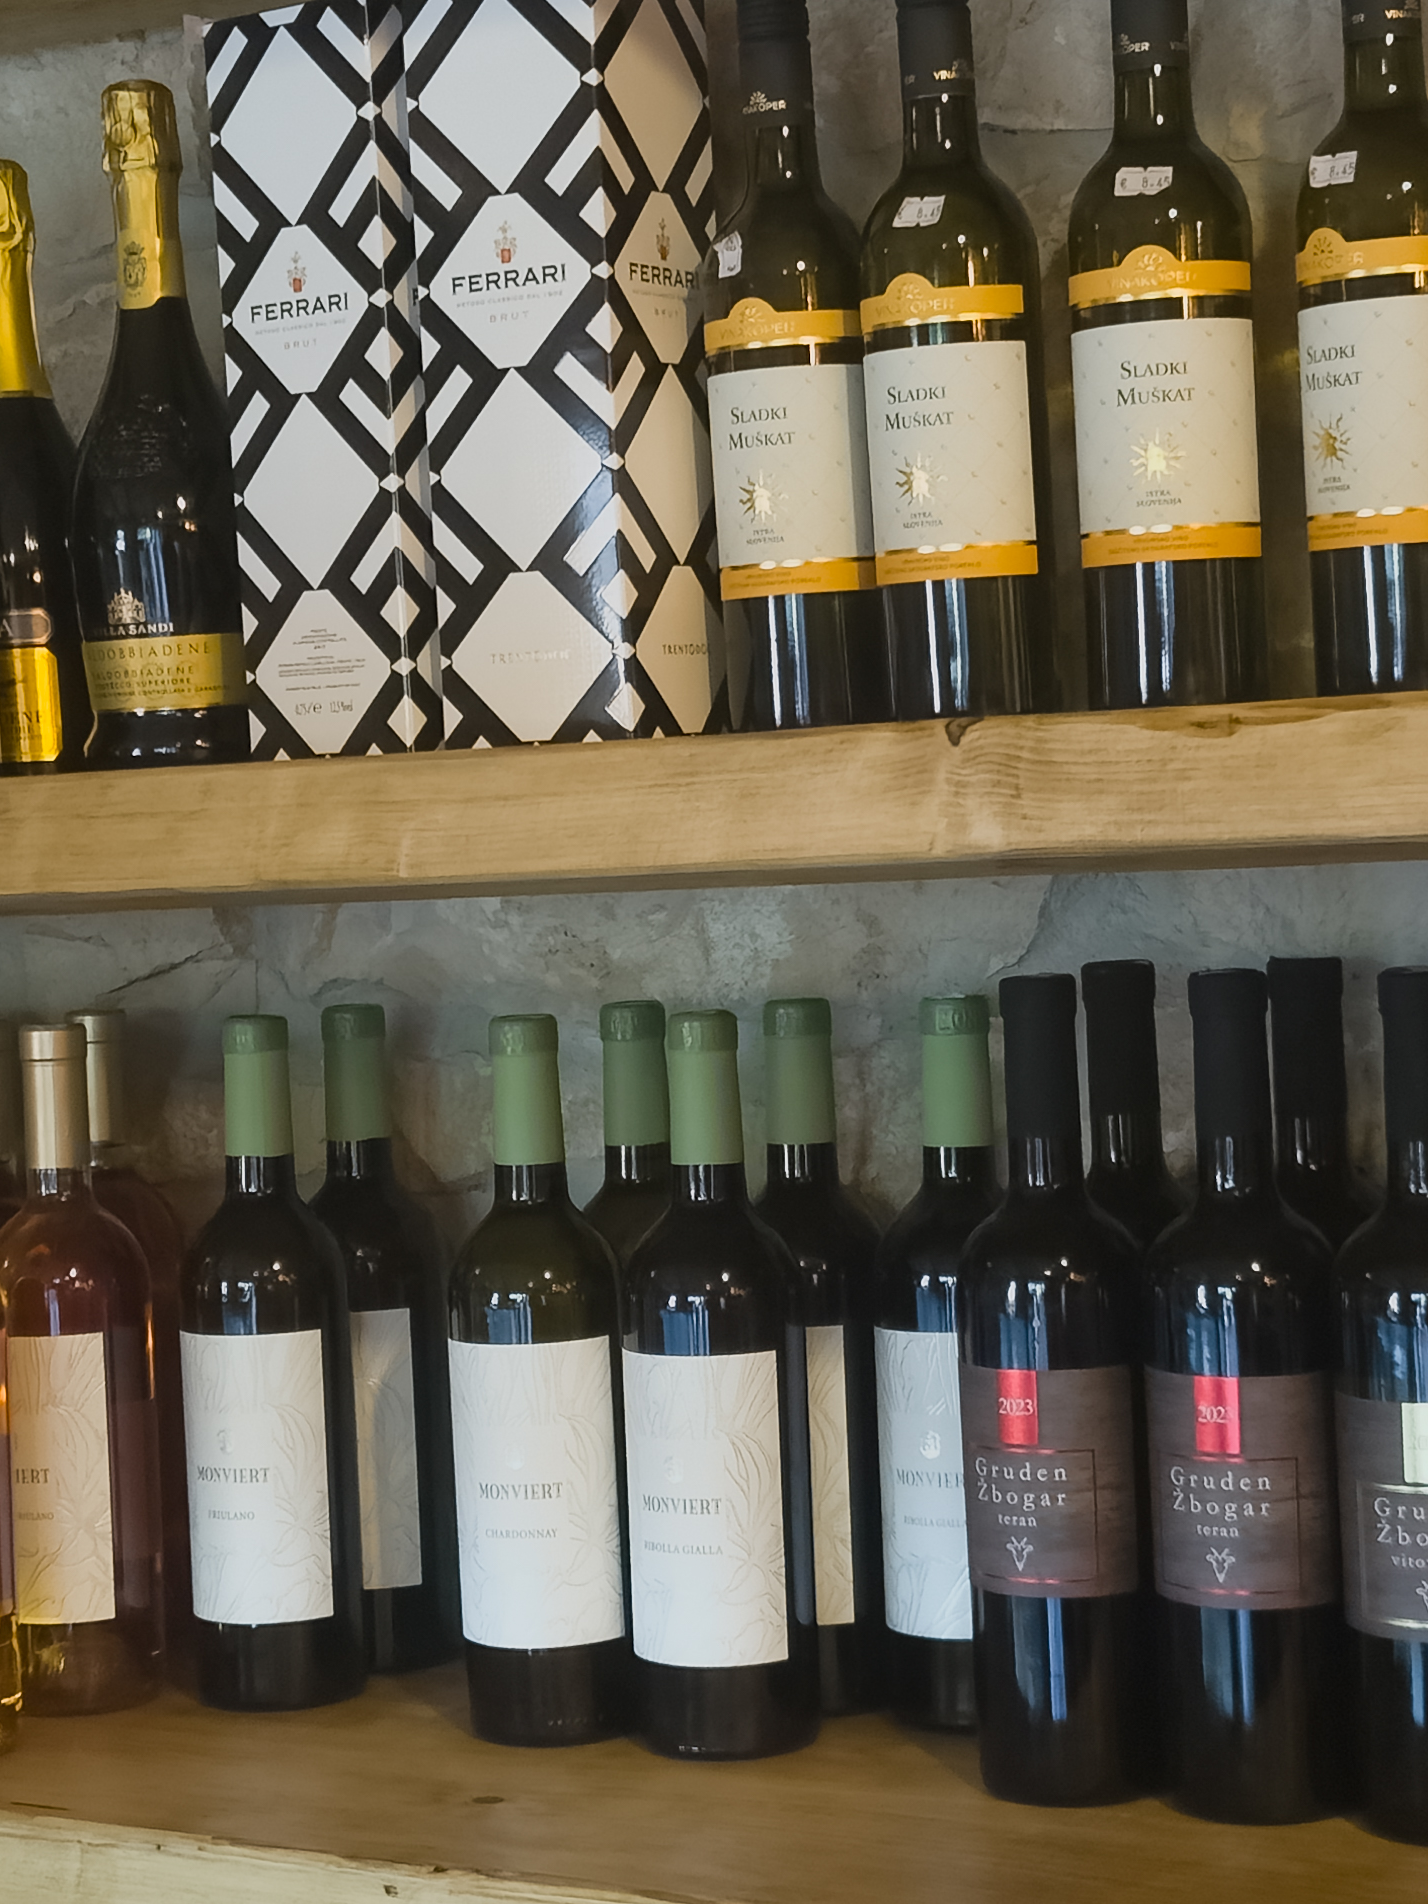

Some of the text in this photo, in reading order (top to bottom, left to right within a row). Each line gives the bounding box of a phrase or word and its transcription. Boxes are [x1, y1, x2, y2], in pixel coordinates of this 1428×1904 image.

[450, 263, 568, 296] FERRARI
[629, 261, 700, 291] FERRARI
[249, 292, 350, 324] FERRARI
[489, 310, 529, 325] BRUT
[1305, 343, 1356, 365] SLADKI
[1118, 359, 1189, 381] SLADKI
[1304, 369, 1363, 393] MUŠKAT
[885, 385, 946, 405] SLADKI
[1115, 385, 1196, 408] MUŠKAT
[729, 404, 788, 424] SLADKI
[884, 410, 954, 432] MUŠKAT
[728, 428, 796, 451] MUŠKAT
[127, 620, 175, 636] SANDI
[997, 1397, 1035, 1416] 2023
[196, 1465, 271, 1485] MONVIERT
[974, 1456, 1068, 1483] Gruden
[1169, 1465, 1272, 1492] Gruden
[478, 1481, 565, 1502] MONVIERT
[976, 1477, 1067, 1511] Žbogar
[641, 1493, 723, 1516] MONVIERT
[1171, 1486, 1272, 1522] Žbogar
[207, 1509, 256, 1522] FRIULANO
[997, 1512, 1038, 1529] teran
[484, 1527, 559, 1540] CHARDONNAY
[1195, 1522, 1240, 1539] teran
[681, 1543, 724, 1557] GIALLA
